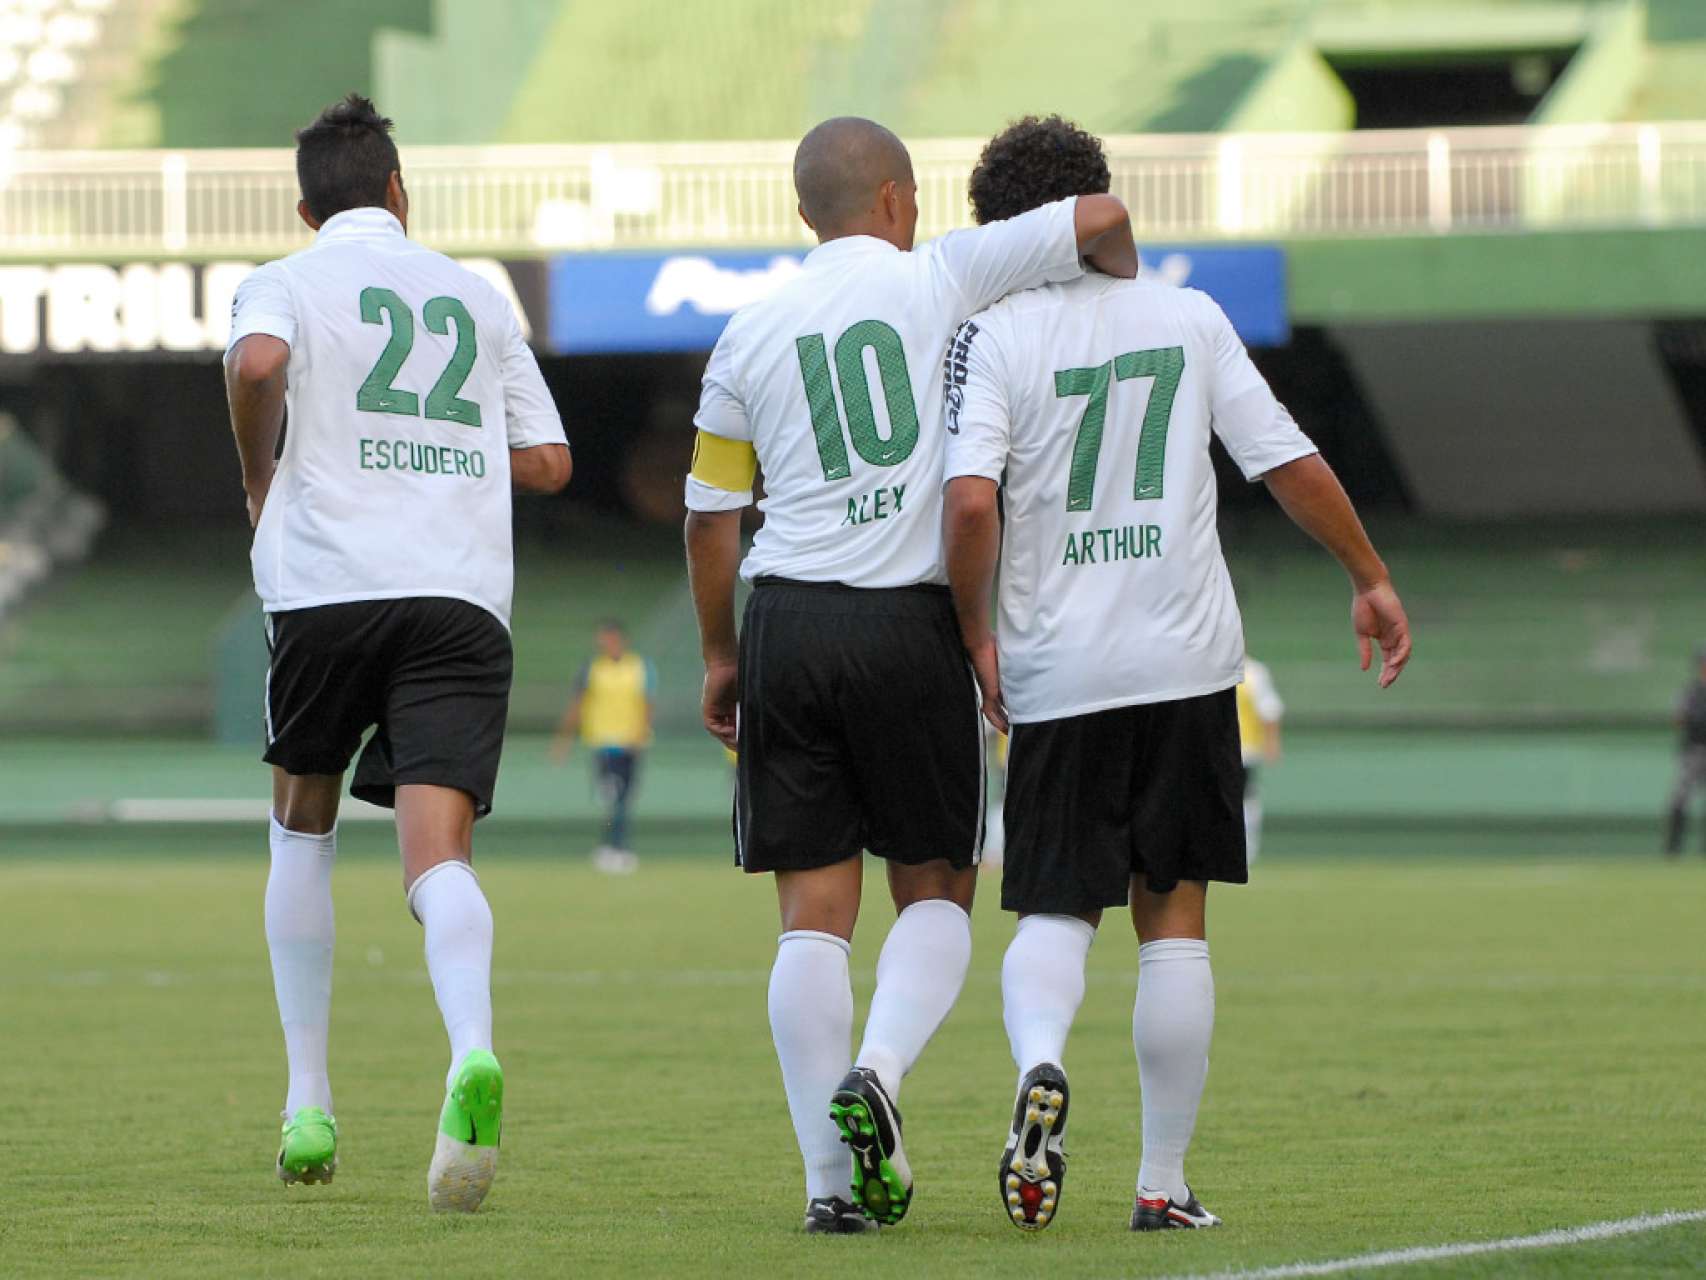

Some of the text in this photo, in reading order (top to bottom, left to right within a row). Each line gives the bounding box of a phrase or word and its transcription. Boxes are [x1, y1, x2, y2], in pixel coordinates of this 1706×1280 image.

[357, 286, 482, 427] 22
[796, 319, 920, 481] 10
[359, 438, 486, 478] ESCUDERO
[1055, 346, 1185, 513] 77
[841, 483, 907, 526] ALEX
[1062, 524, 1162, 565] ARTHUR
